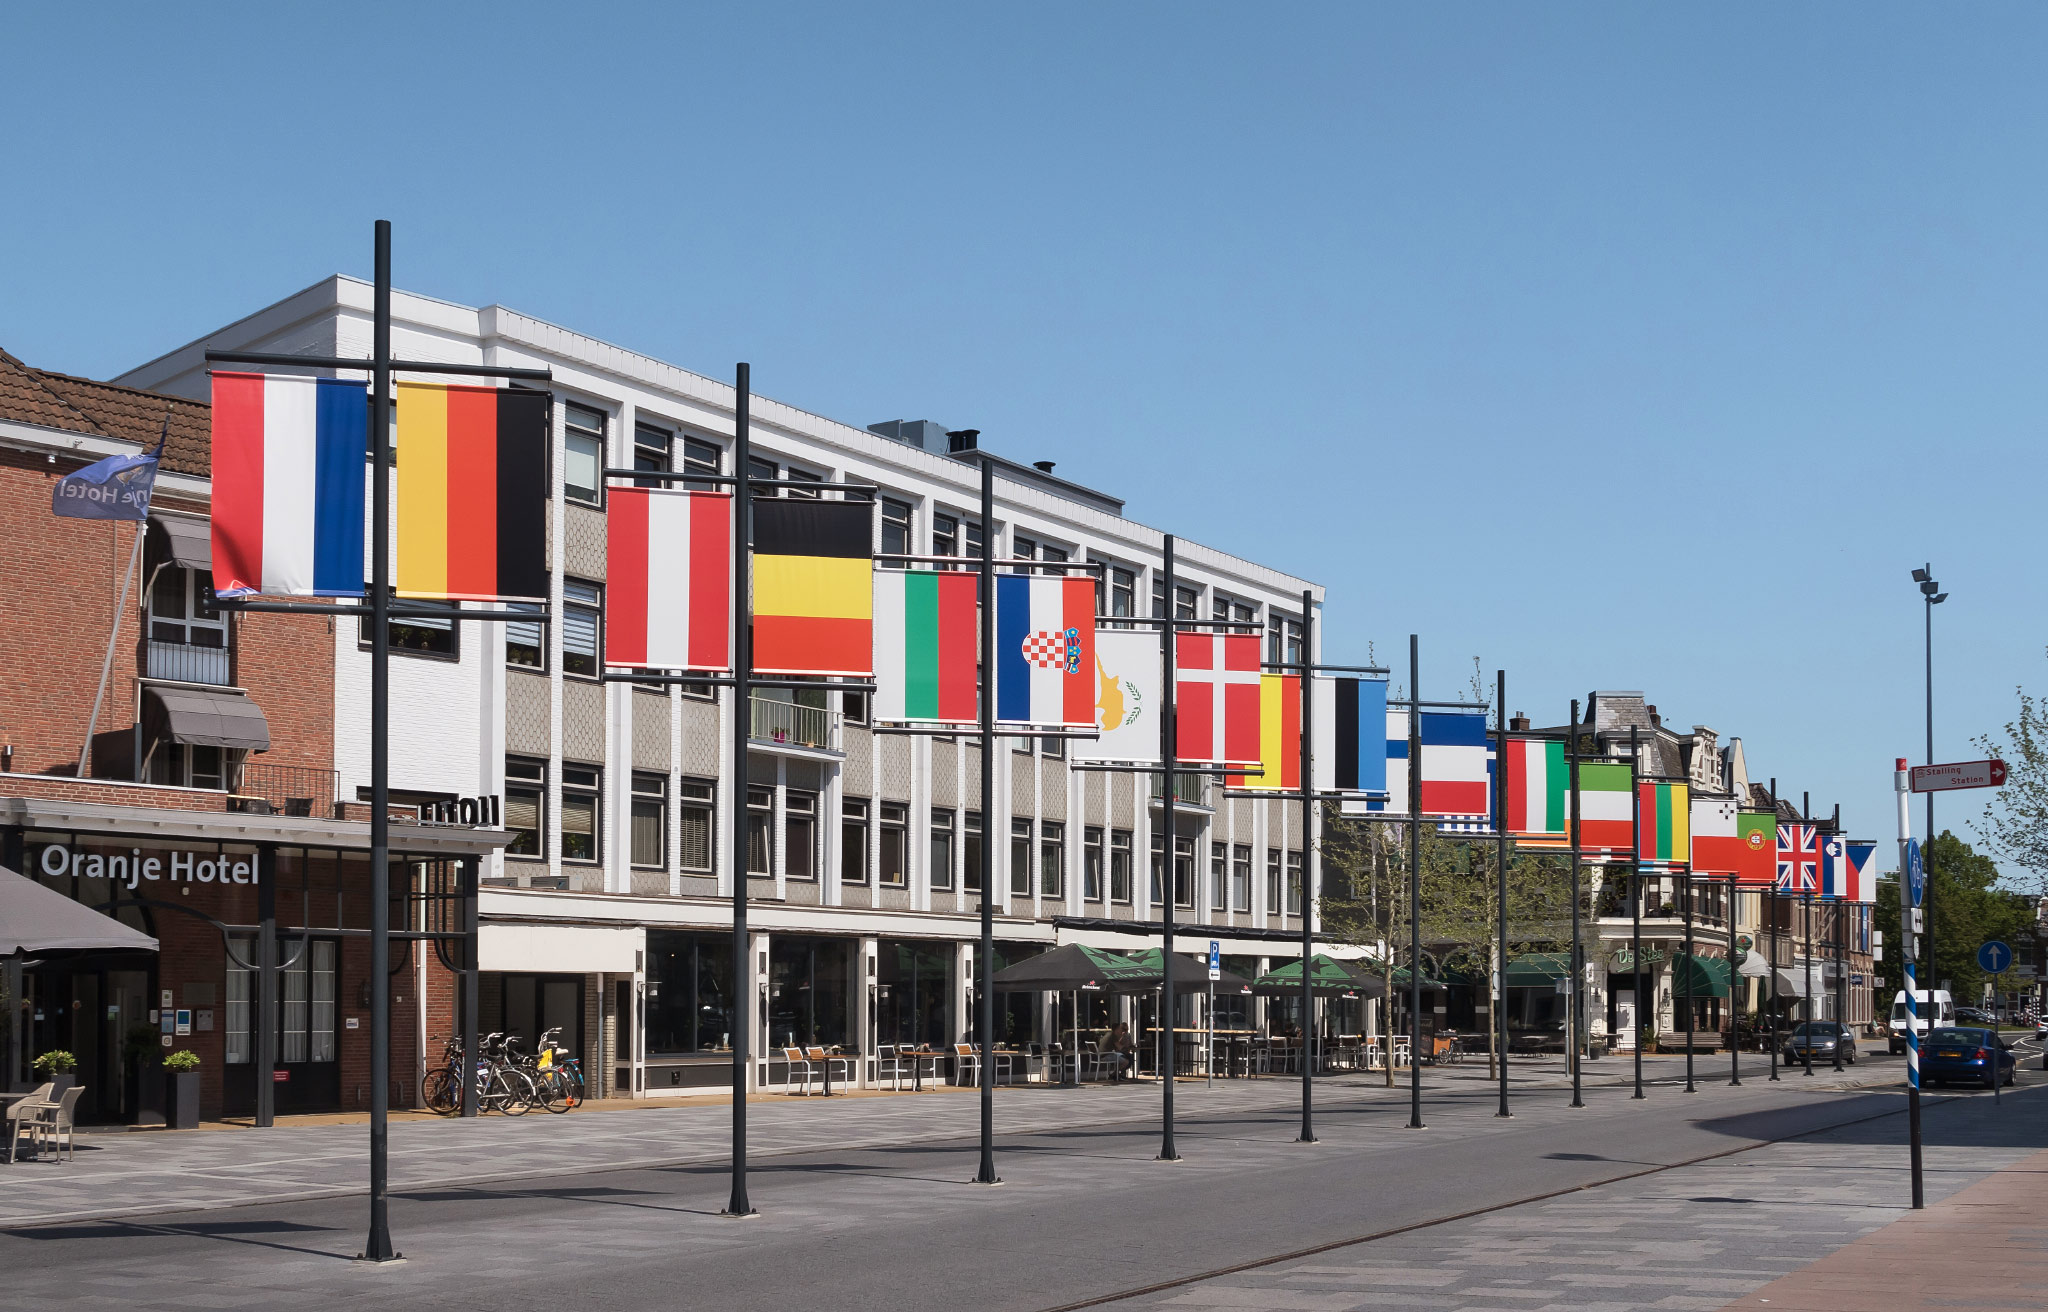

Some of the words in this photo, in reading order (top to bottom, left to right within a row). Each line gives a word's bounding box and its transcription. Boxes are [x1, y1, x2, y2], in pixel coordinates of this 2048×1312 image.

[1926, 767, 1961, 776] Stalling
[1951, 776, 1984, 785] Station
[41, 844, 161, 890] Oranje
[170, 851, 259, 884] Hotel
[1212, 943, 1218, 958] P
[1616, 948, 1635, 964] De
